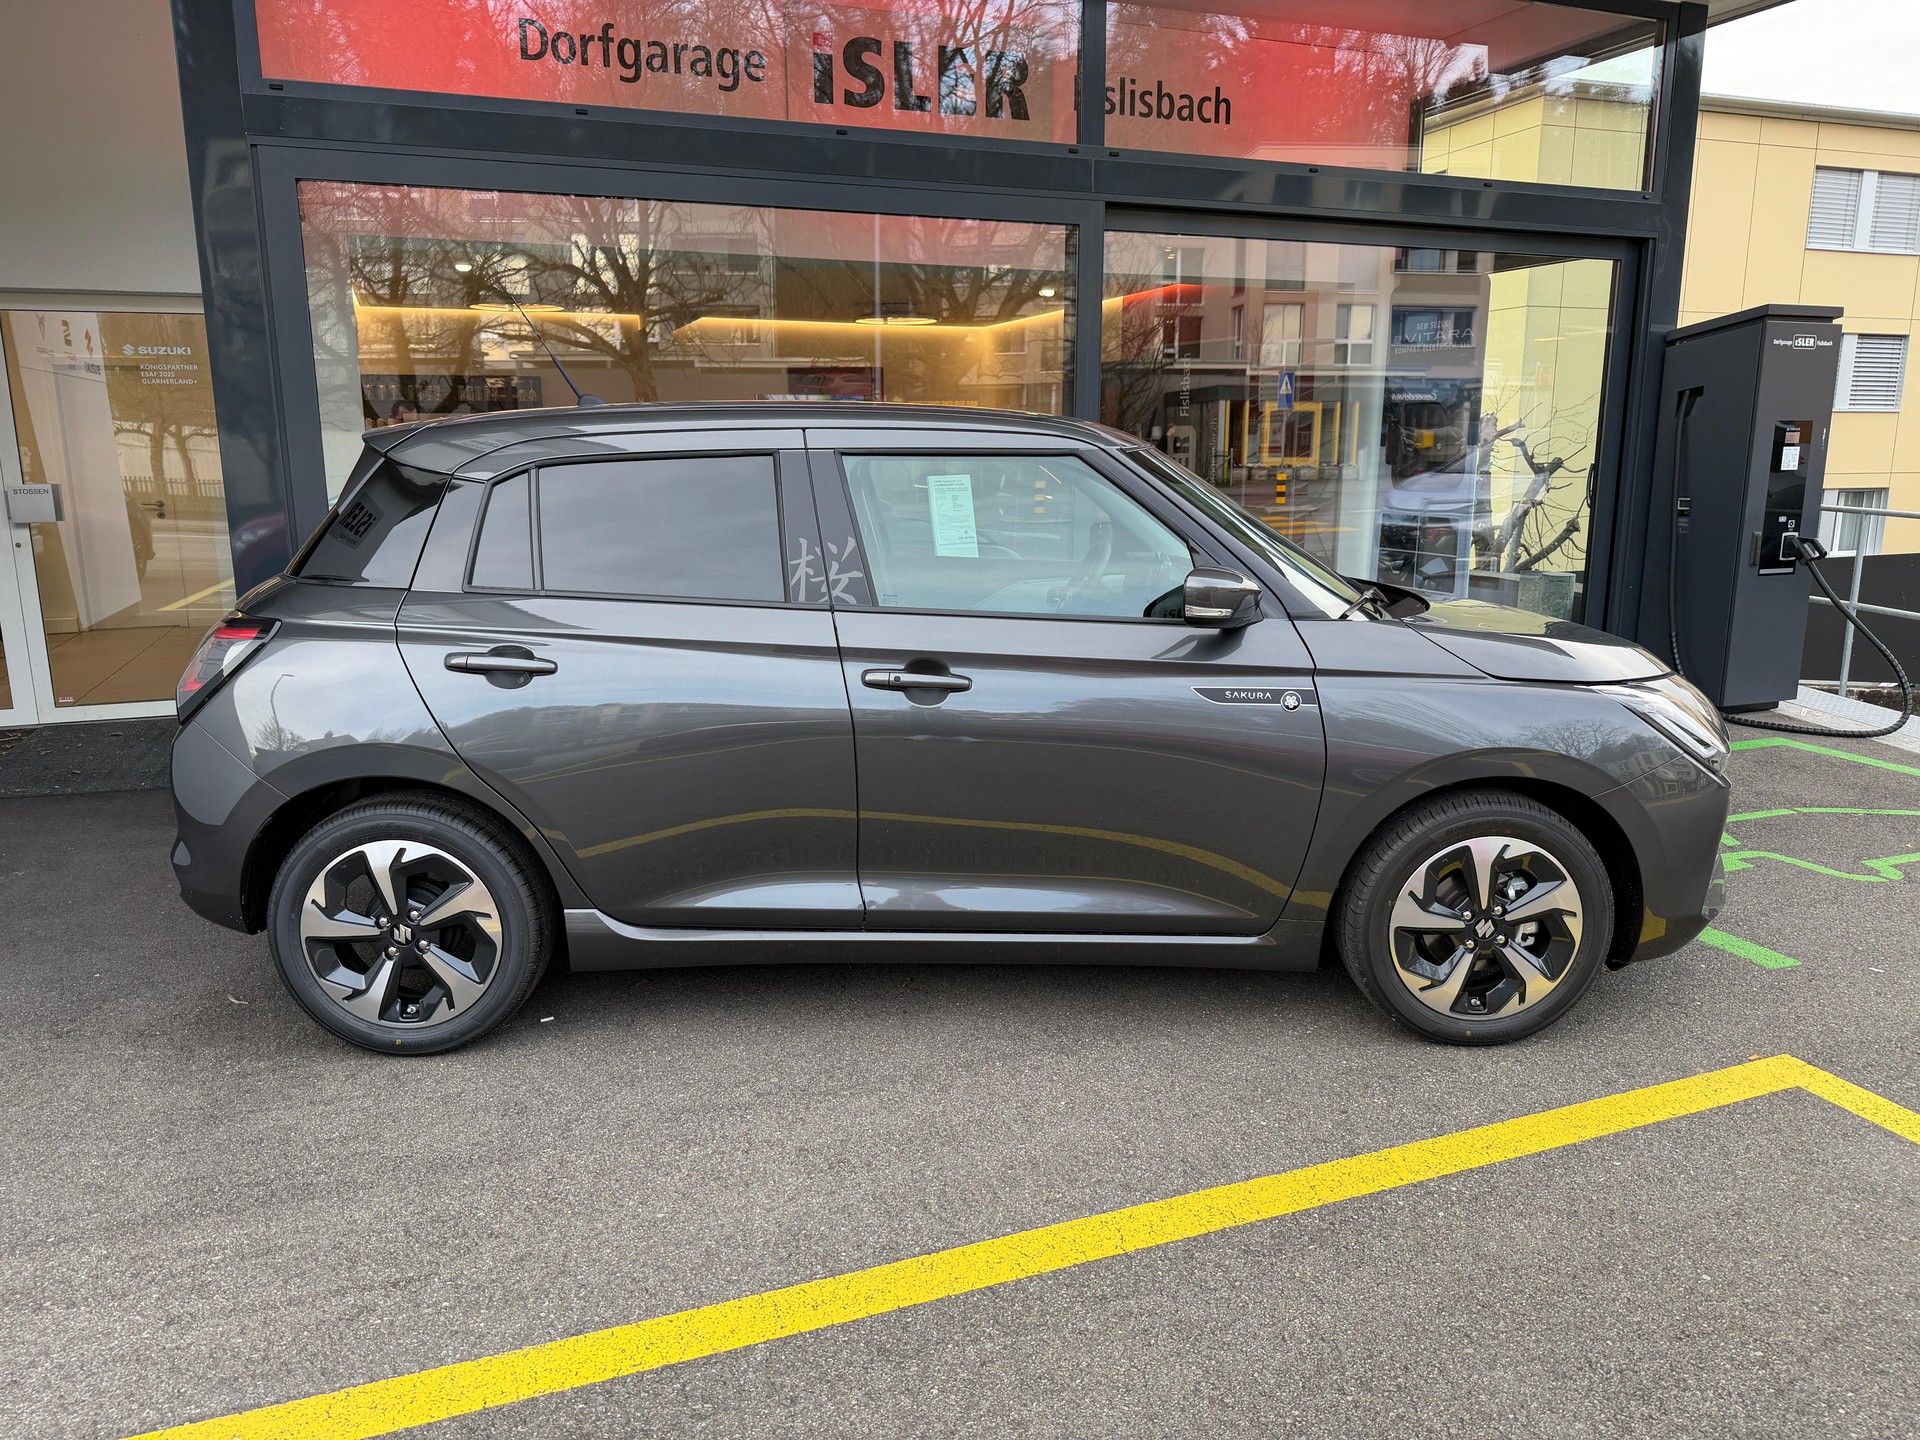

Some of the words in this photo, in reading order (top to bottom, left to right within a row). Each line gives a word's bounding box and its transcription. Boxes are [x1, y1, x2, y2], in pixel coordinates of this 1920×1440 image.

[518, 17, 767, 92] Dorfgarage
[812, 32, 1031, 121] iSLER
[1074, 74, 1232, 125] slisbach
[1430, 320, 1451, 330] SUZUKI
[1795, 338, 1814, 346] iSLER
[137, 346, 192, 355] SUZUKI
[140, 363, 199, 371] KÖNIGSPARTNER
[1180, 352, 1191, 417] Fislisbach
[1224, 690, 1273, 700] SAKURA
